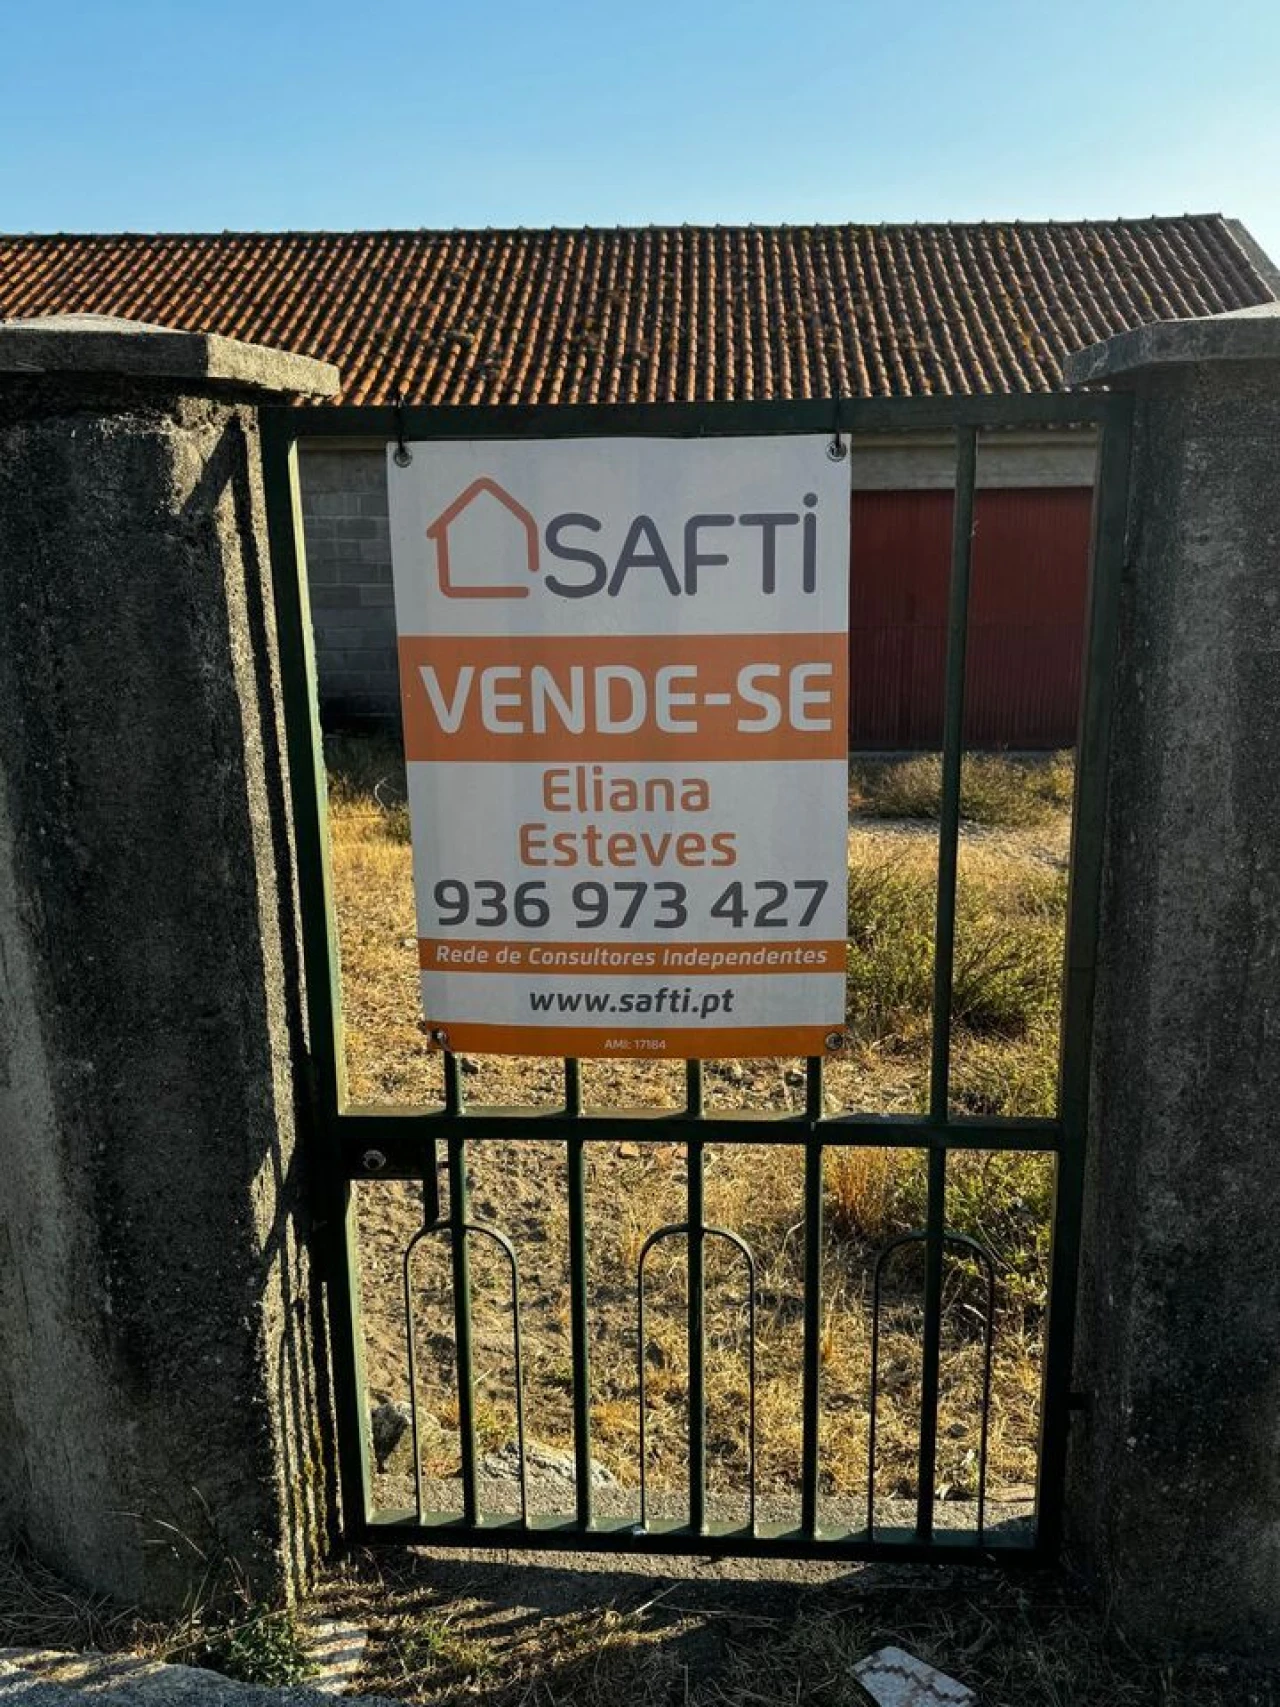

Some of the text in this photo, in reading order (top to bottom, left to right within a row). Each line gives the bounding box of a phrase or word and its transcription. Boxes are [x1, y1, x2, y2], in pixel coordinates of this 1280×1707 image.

[418, 662, 833, 734] VENDE-SE
[543, 765, 710, 813] Eliana
[519, 823, 737, 867] Esteves
[433, 879, 829, 928] 936 973 427
[436, 945, 828, 970] Rede de Consultores Independentes
[529, 988, 735, 1019] www.safti.pt
